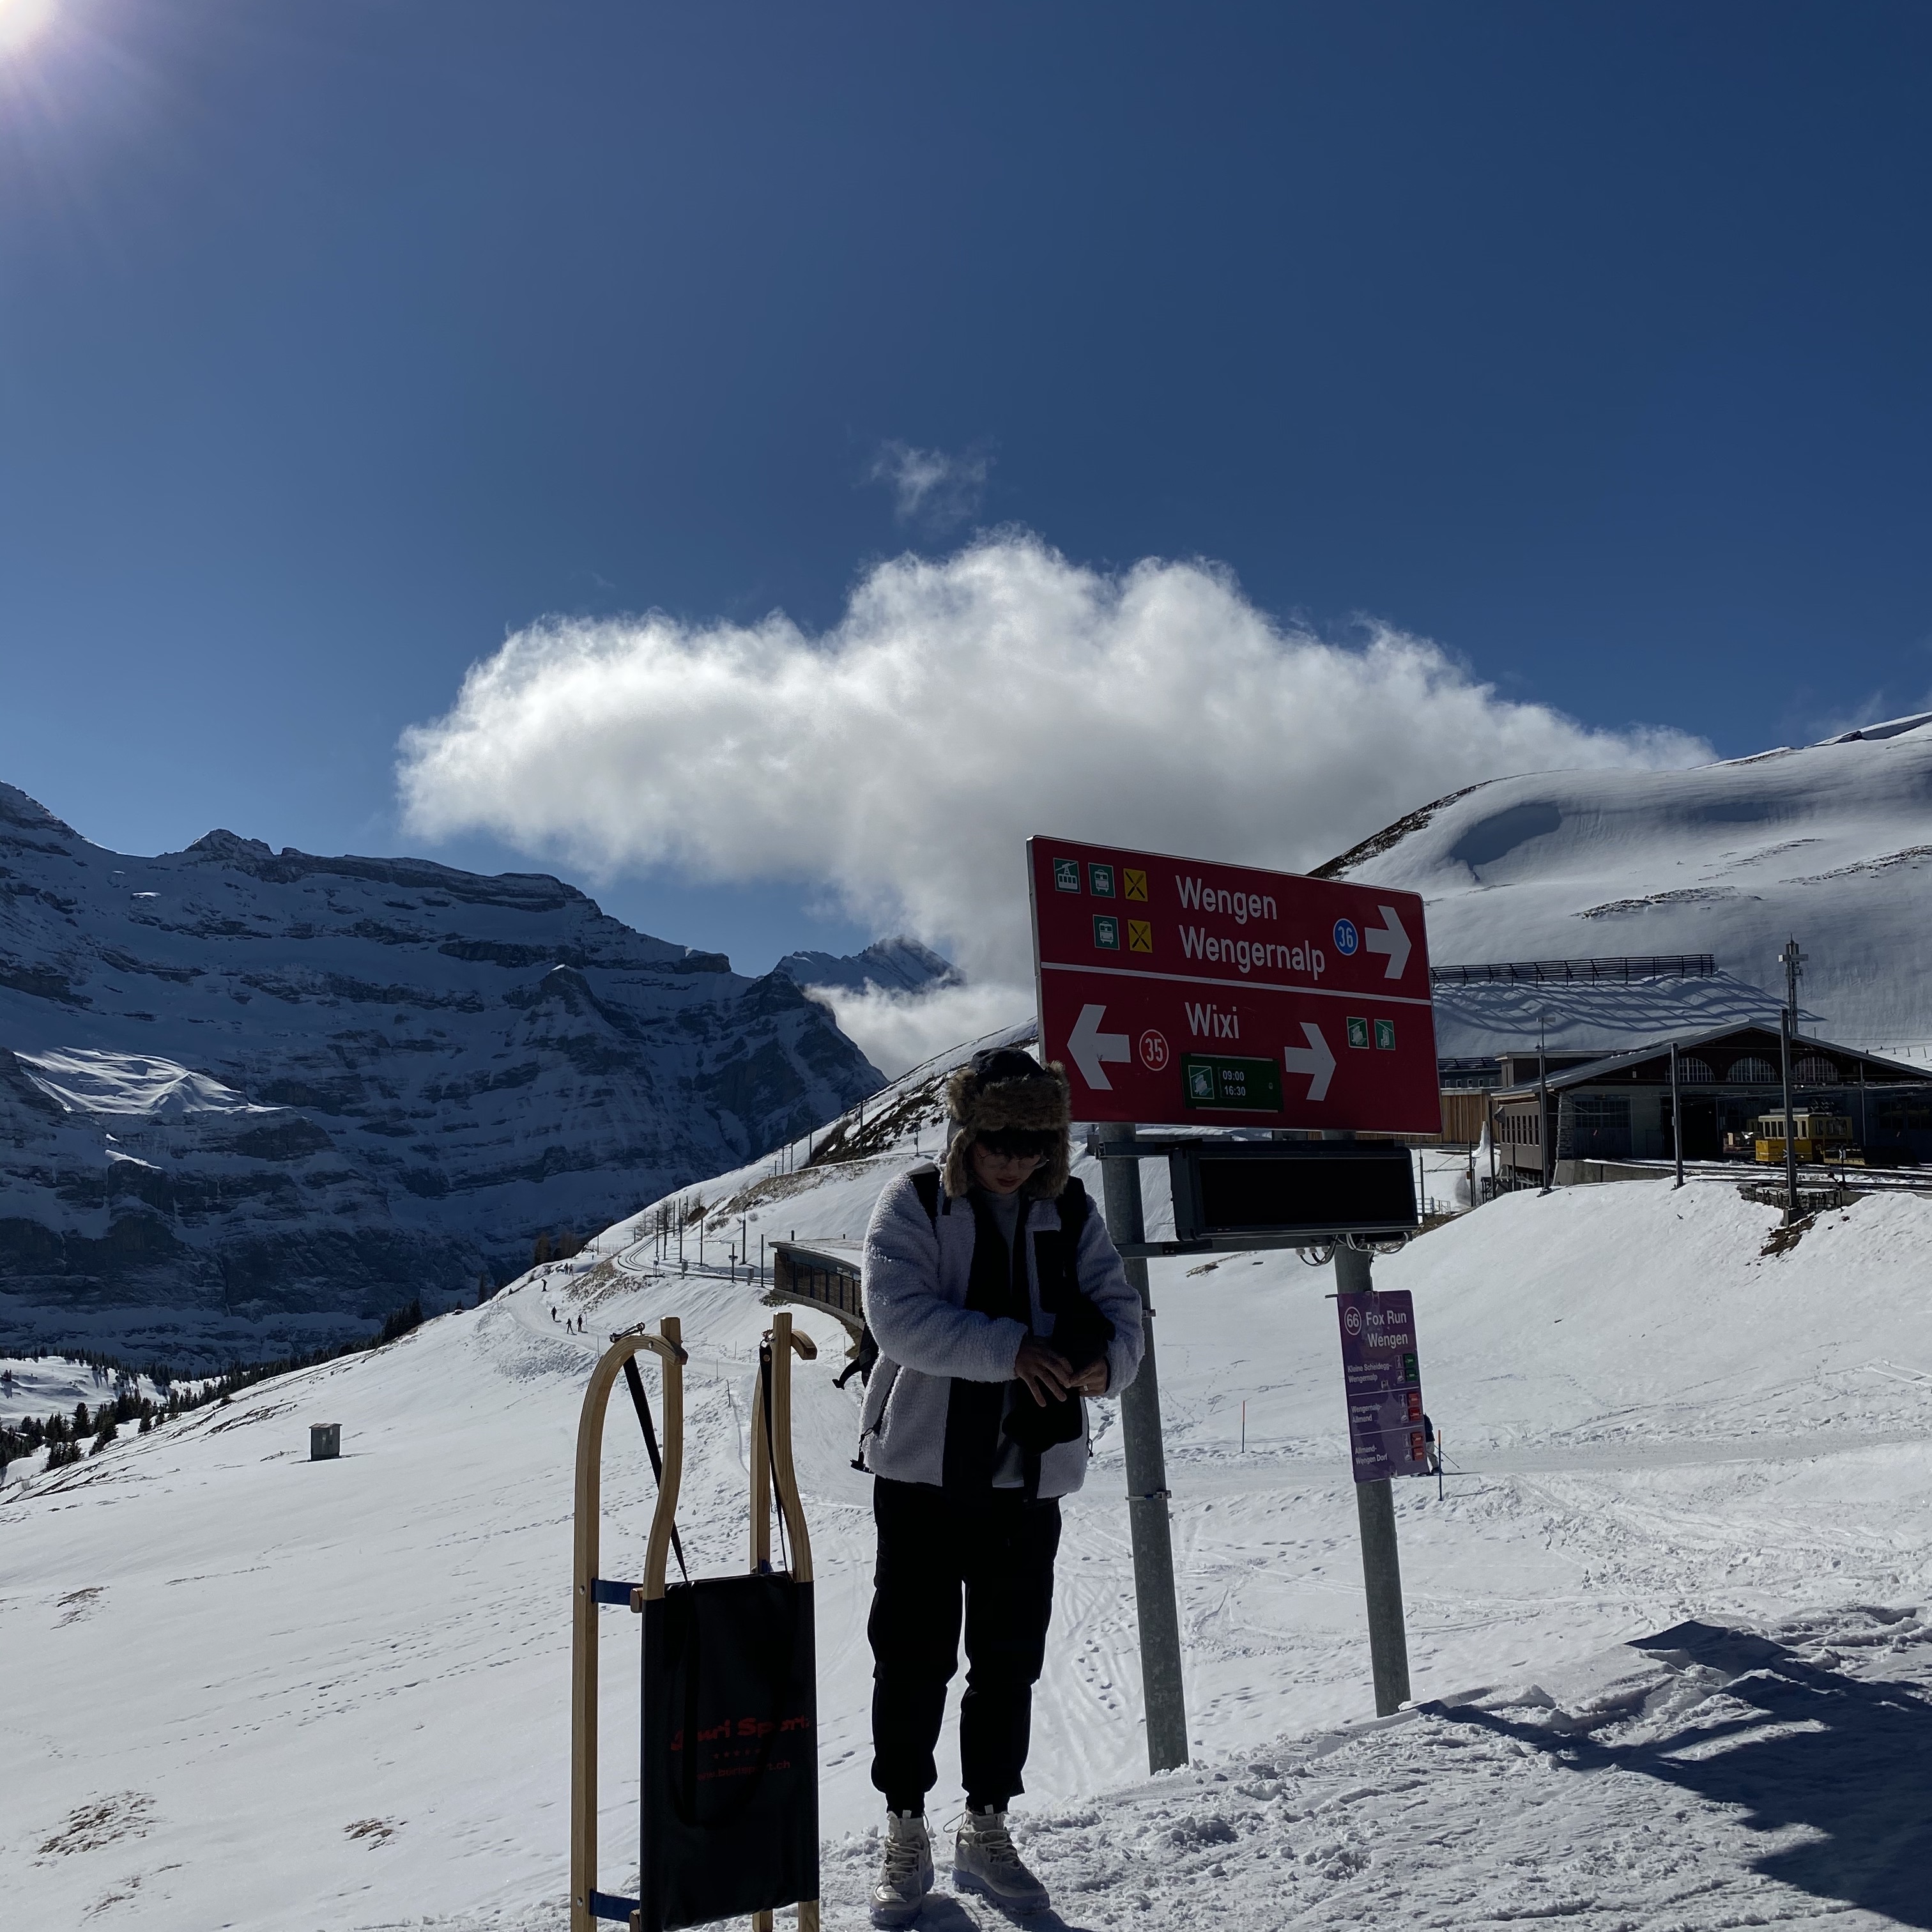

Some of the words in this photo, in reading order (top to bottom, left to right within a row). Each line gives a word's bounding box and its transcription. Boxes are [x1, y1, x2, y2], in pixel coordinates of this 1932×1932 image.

[1175, 875, 1277, 924] Wengen
[1337, 926, 1353, 948] 36
[1179, 924, 1325, 981] Wengernalp
[1184, 1002, 1239, 1039] Wixi
[1145, 1038, 1163, 1062] 35
[1222, 1070, 1245, 1082] 09:00
[1224, 1085, 1246, 1096] 16:30
[1346, 1313, 1360, 1328] 66
[1365, 1311, 1385, 1326] Fox
[1386, 1310, 1407, 1324] Run
[1367, 1333, 1408, 1349] Wengen
[1347, 1365, 1363, 1373] Kleine
[1348, 1374, 1377, 1383] Wengernalp
